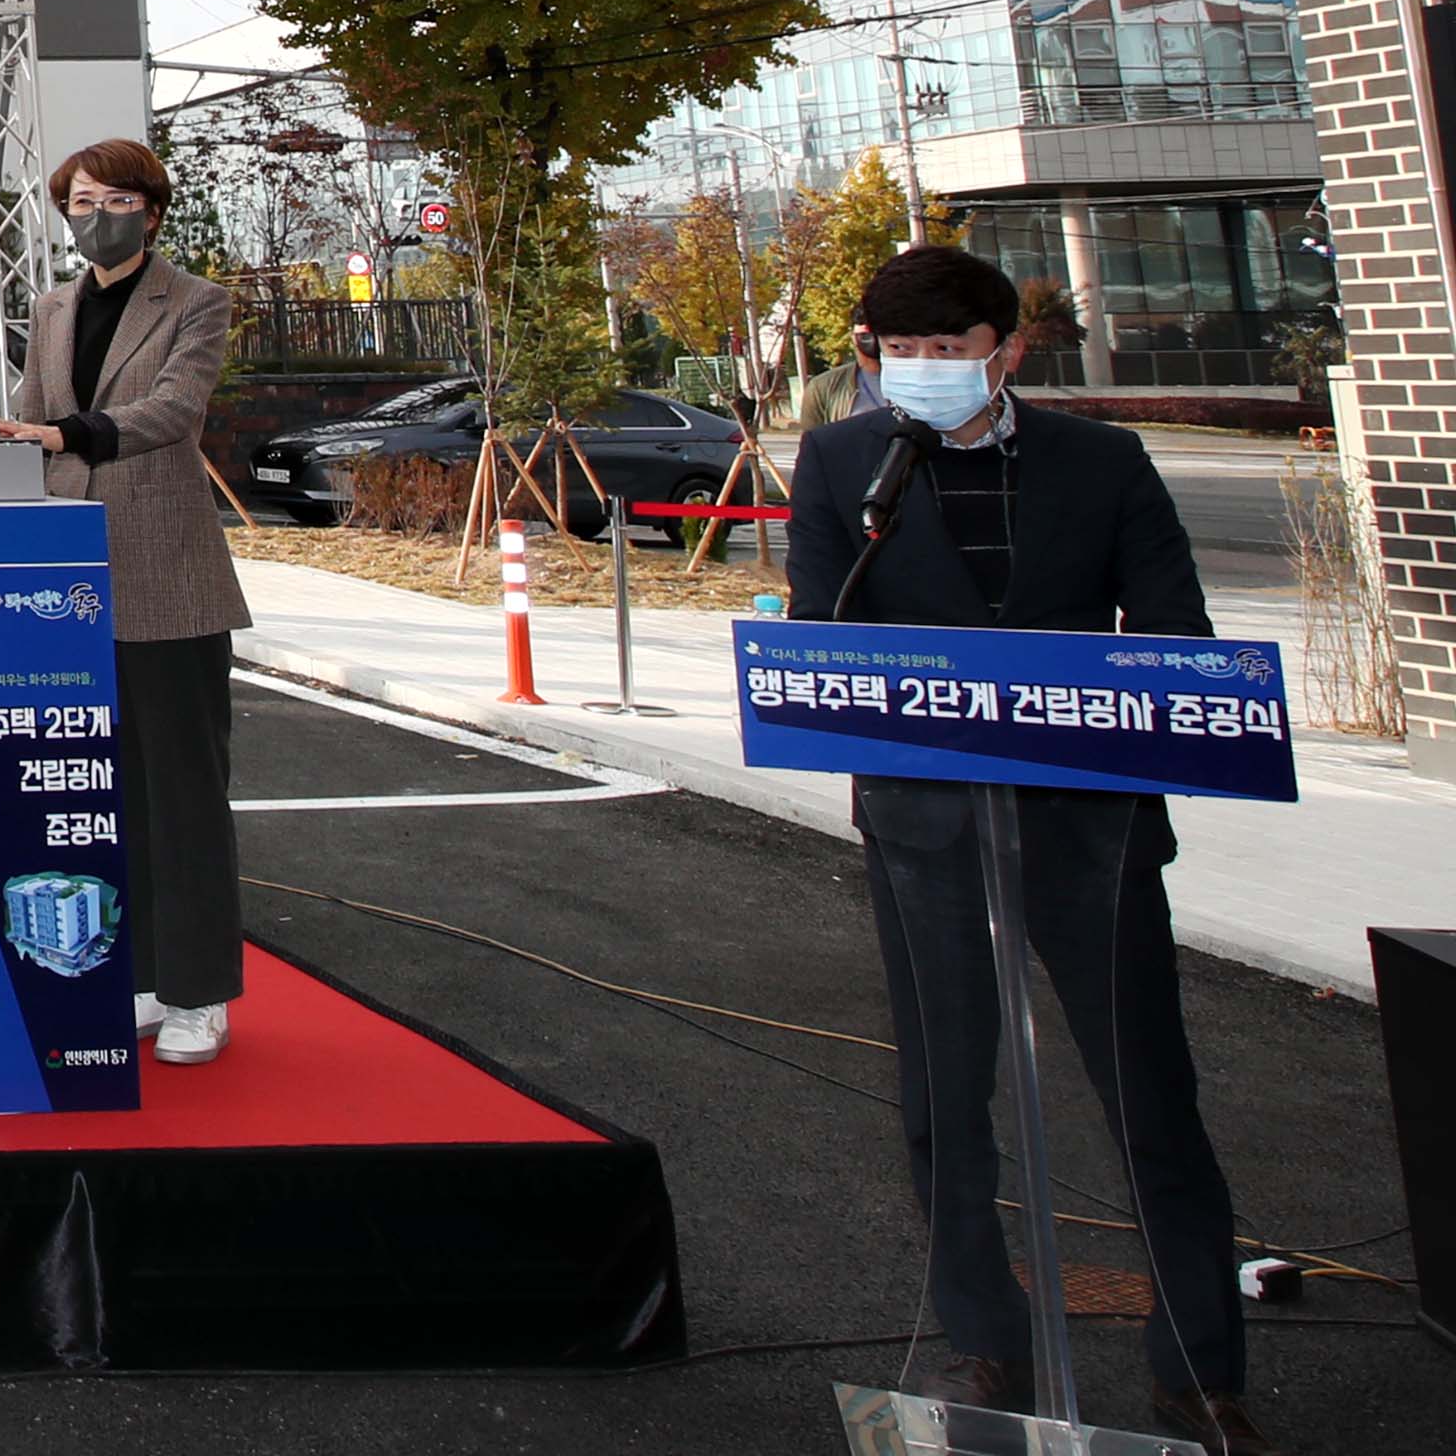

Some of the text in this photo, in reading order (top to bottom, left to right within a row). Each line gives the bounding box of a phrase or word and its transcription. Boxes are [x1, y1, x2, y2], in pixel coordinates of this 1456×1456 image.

[427, 211, 445, 225] 50
[747, 666, 1283, 740] 행복주택 2단계 건립공사 준공식
[44, 706, 111, 739] 2단계
[19, 758, 114, 792] 건립공사
[45, 813, 118, 846] 준공식
